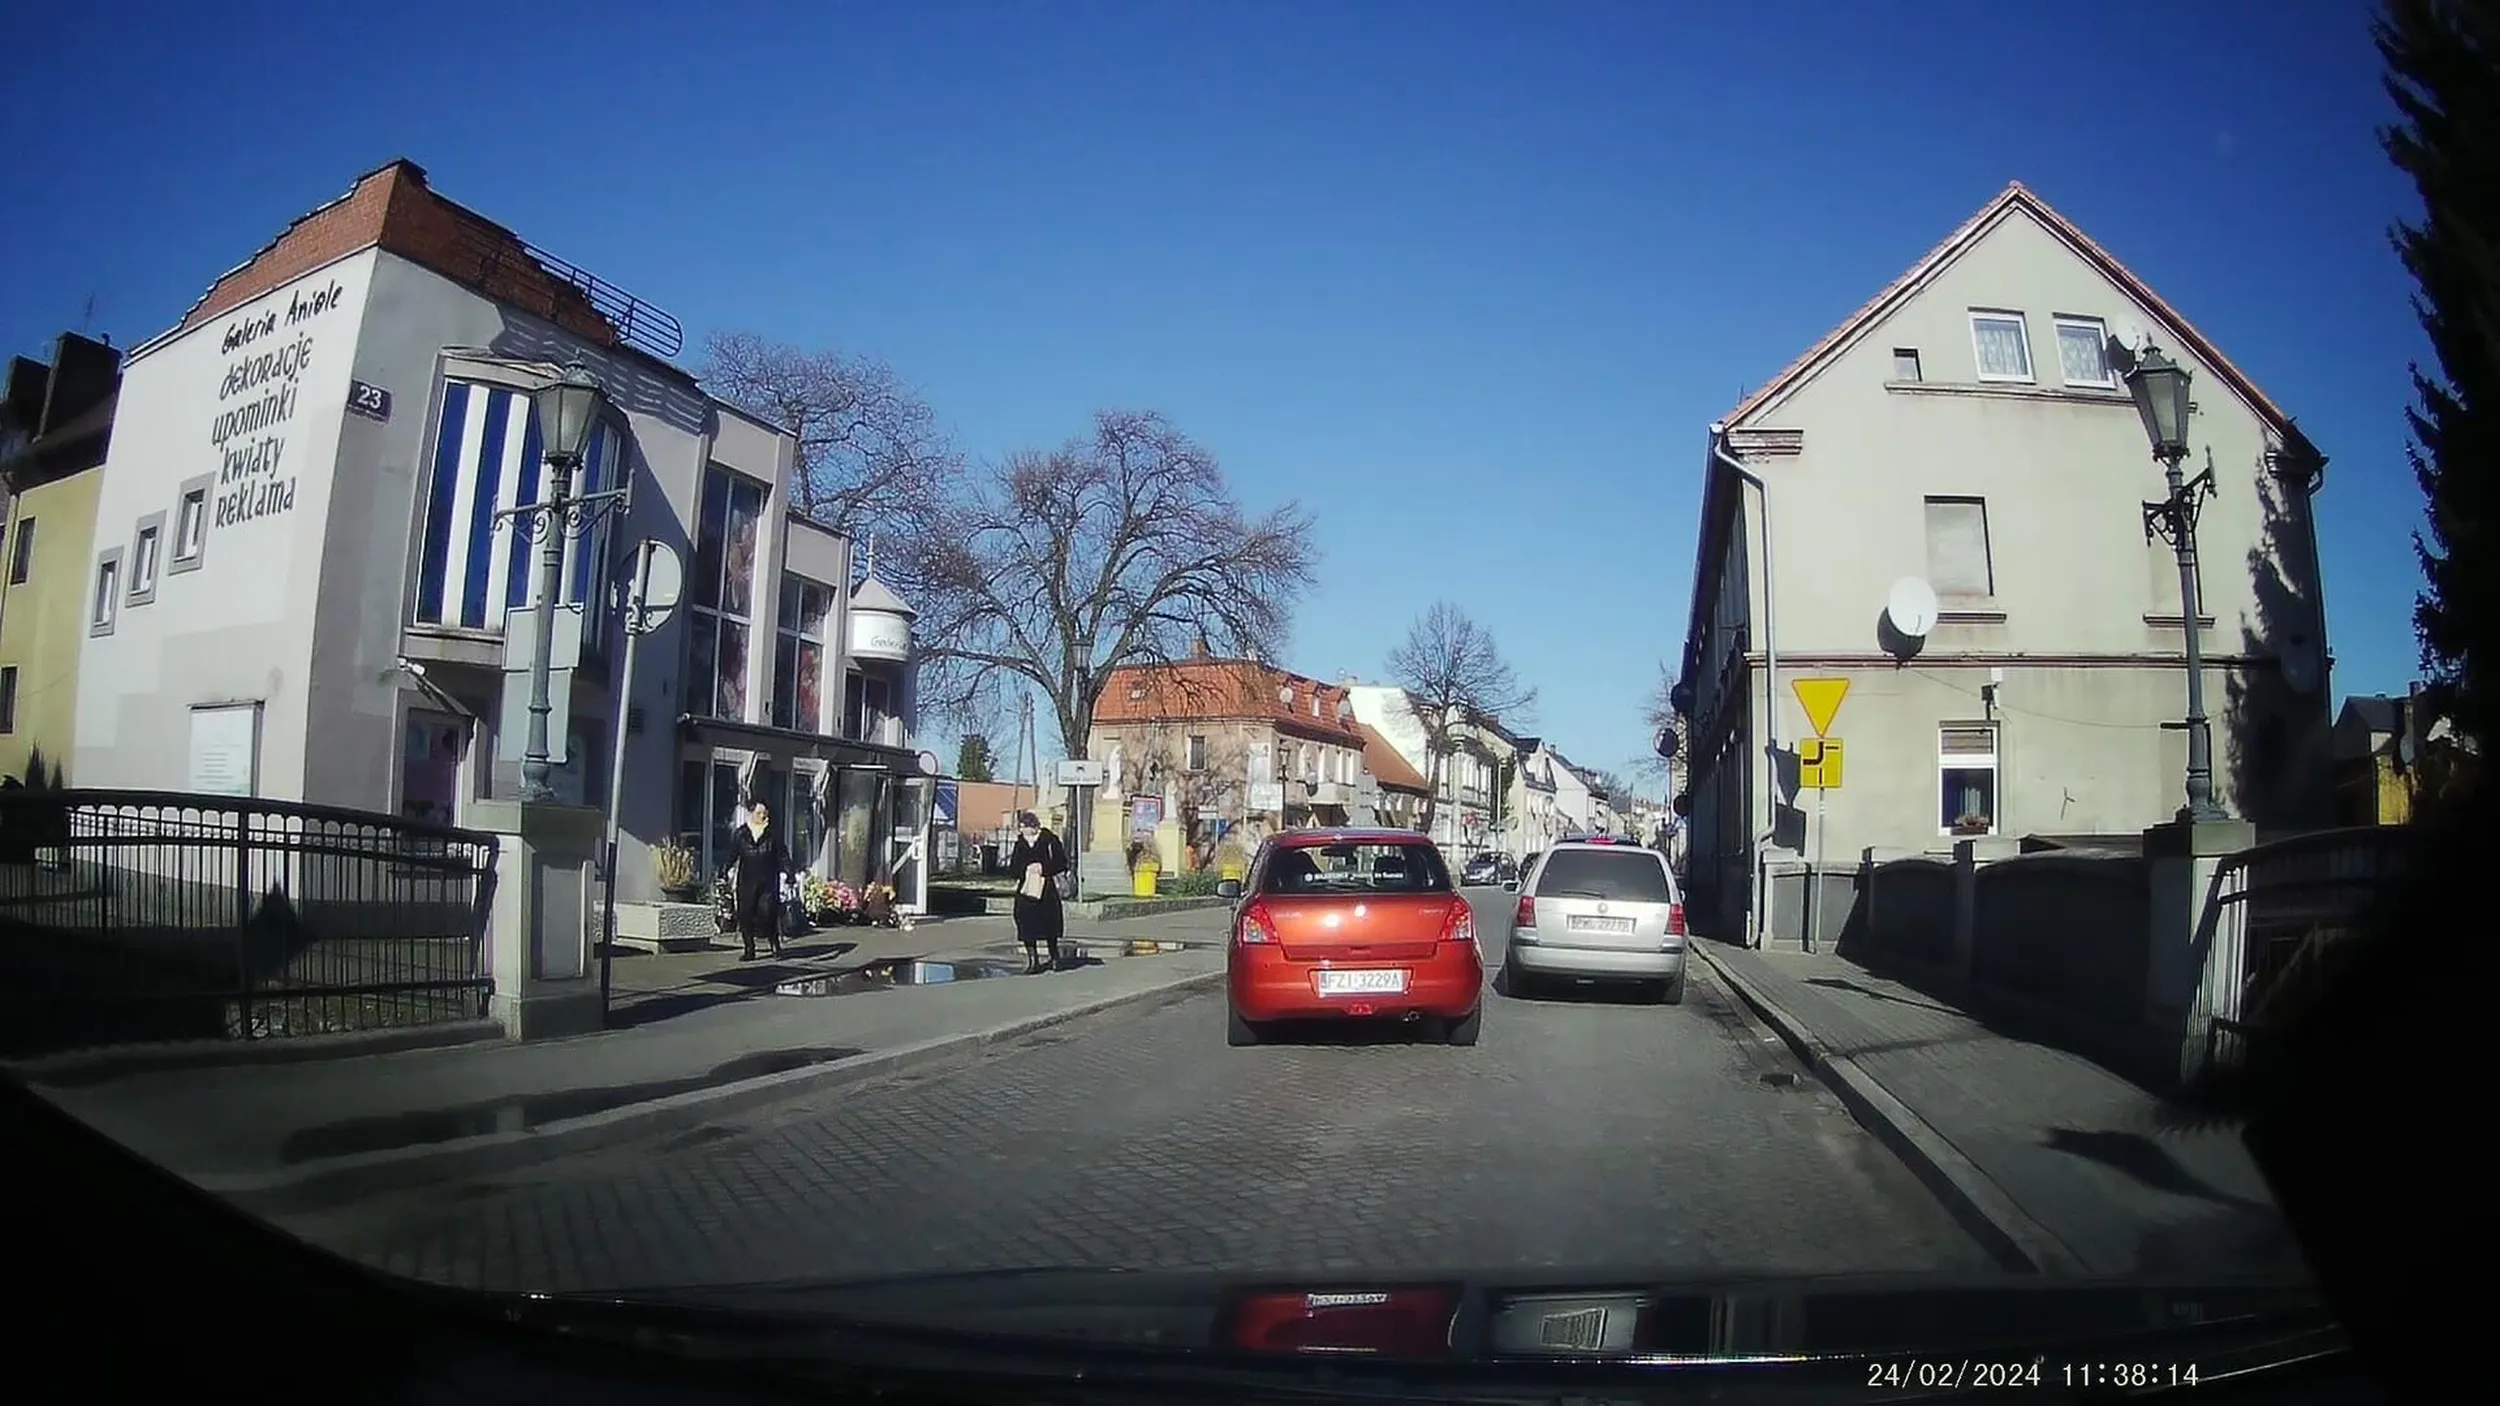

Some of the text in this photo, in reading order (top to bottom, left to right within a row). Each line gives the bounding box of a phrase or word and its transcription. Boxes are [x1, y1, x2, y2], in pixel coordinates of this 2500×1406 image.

[222, 310, 277, 355] Galeria
[212, 378, 299, 453] upominki
[357, 385, 382, 409] 23
[221, 437, 285, 486] kwiaty
